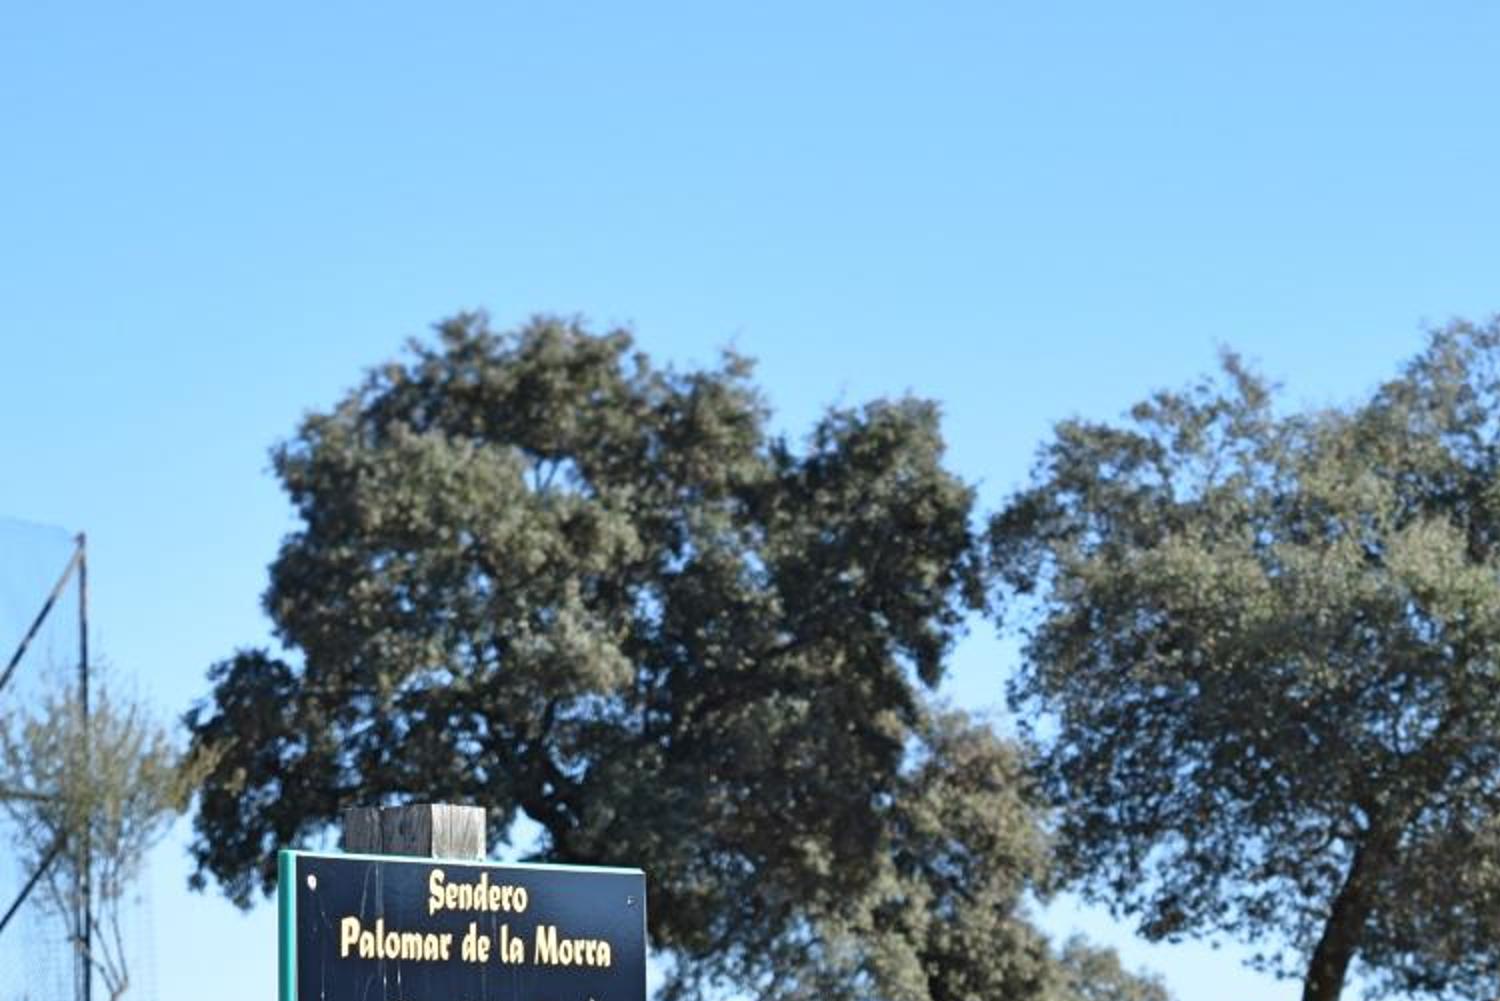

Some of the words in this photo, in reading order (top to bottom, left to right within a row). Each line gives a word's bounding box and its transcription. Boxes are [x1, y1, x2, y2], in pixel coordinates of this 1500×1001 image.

[427, 867, 529, 916] Sendero
[340, 915, 453, 962] Palomar
[461, 921, 491, 963] de
[500, 923, 525, 965] la
[533, 924, 612, 968] Morra
